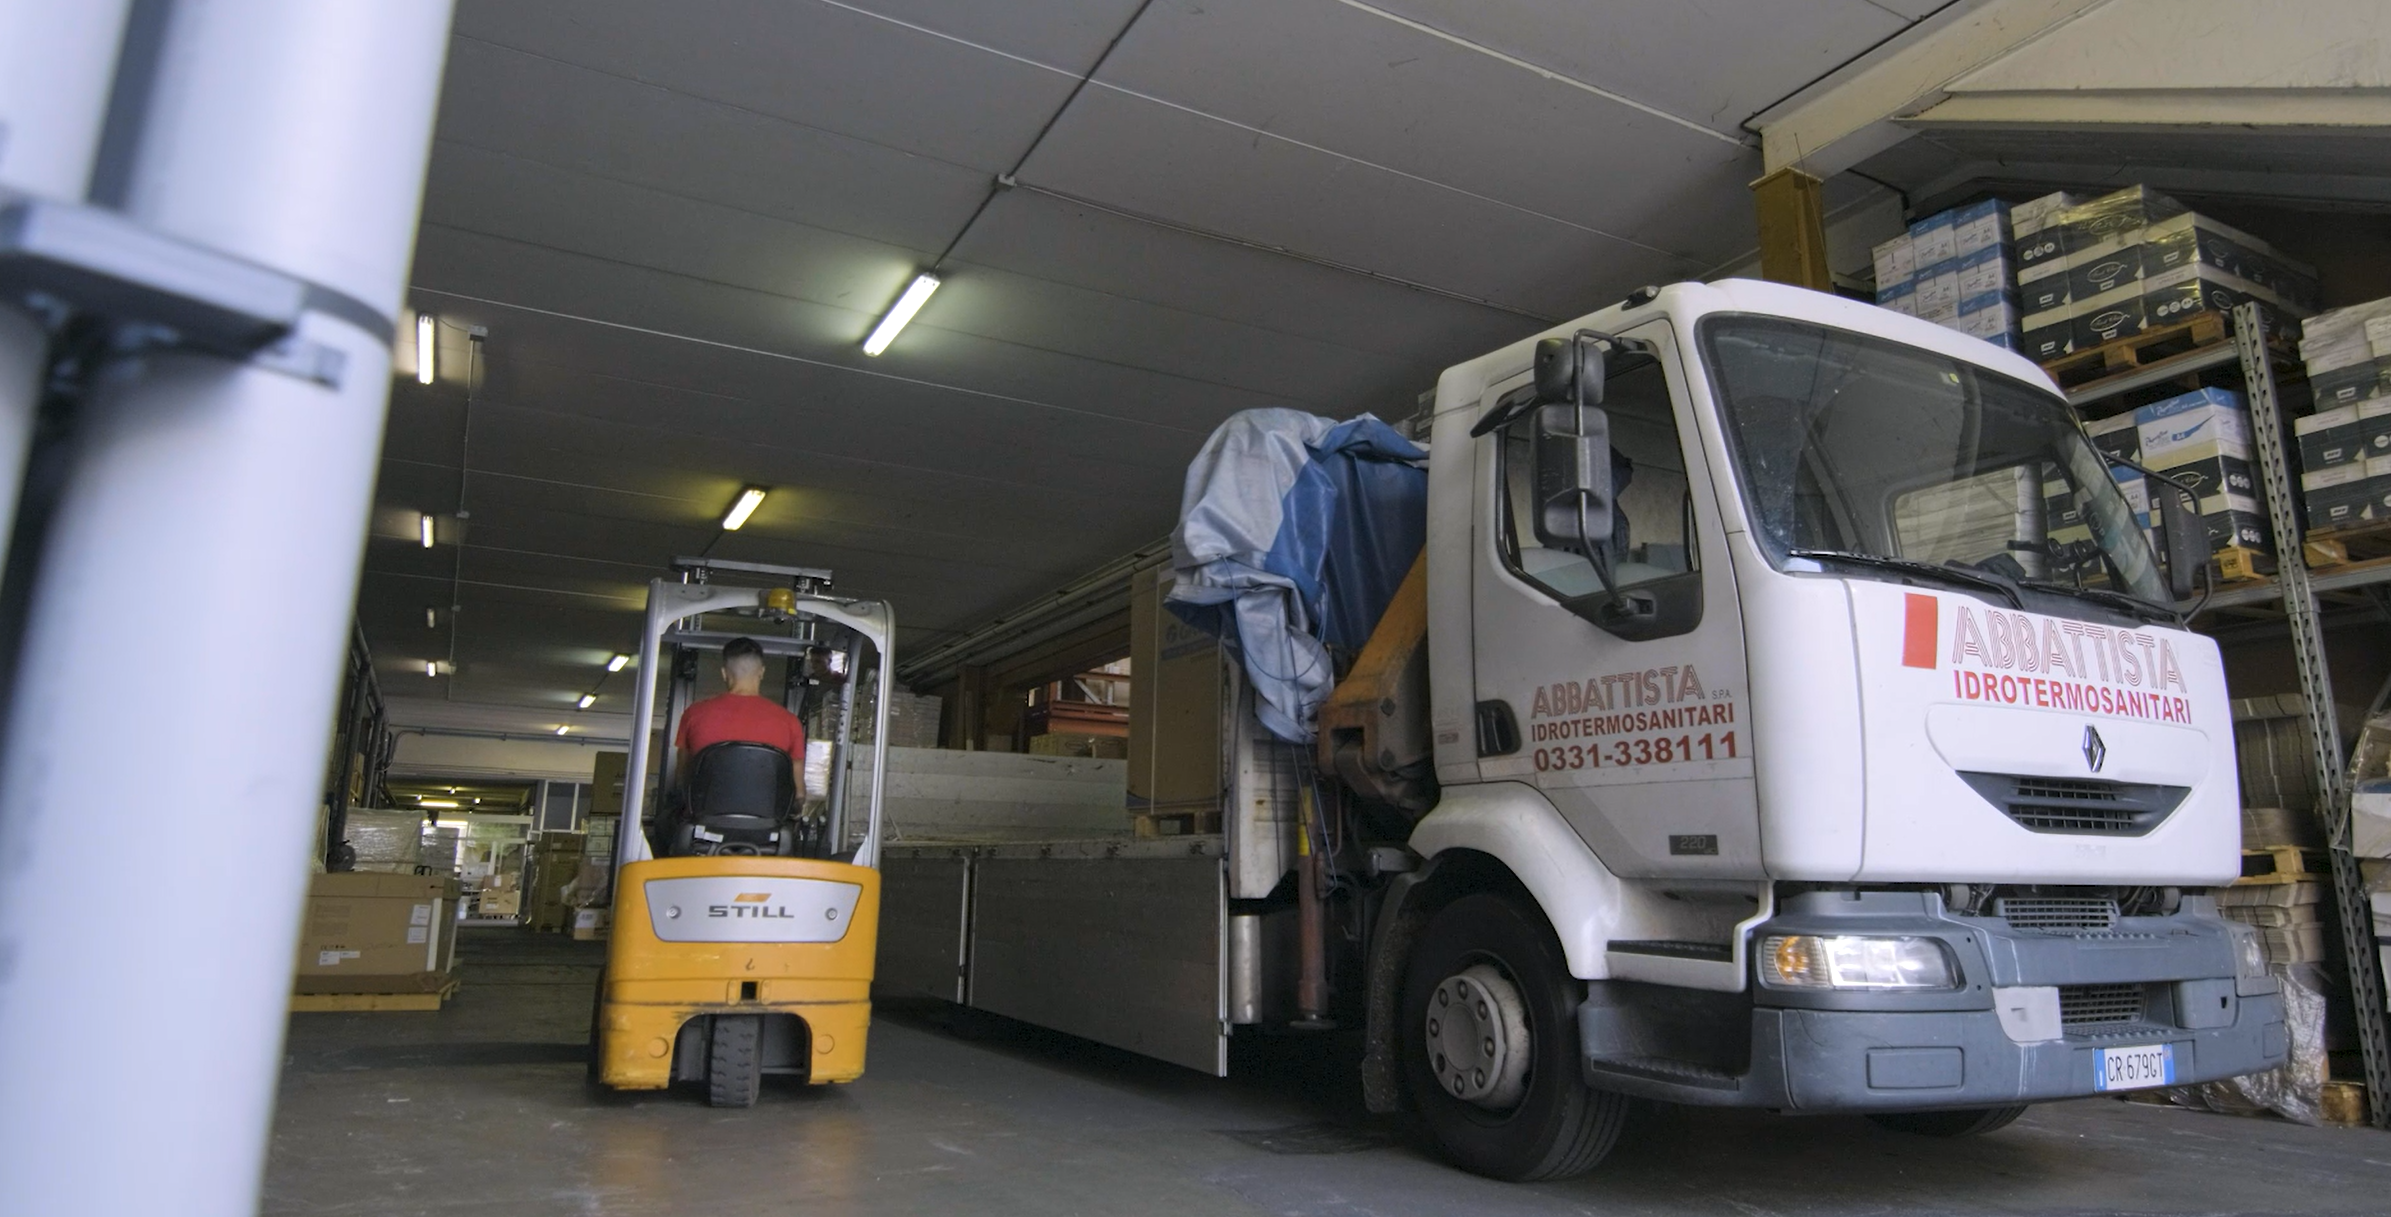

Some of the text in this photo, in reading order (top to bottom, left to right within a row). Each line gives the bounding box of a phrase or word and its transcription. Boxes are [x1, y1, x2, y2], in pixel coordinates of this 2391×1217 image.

[1952, 606, 2187, 693] ABBATTISTA
[1531, 664, 1705, 719] ABBATTISTA
[1953, 669, 2192, 724] IDROTERMOSANITARI
[1532, 702, 1734, 742] IDROTERMOSANITARI
[1534, 731, 1737, 772] 0331-338111
[1680, 836, 1706, 849] 220
[708, 905, 795, 918] STILL
[2107, 1052, 2163, 1082] CR 679GT
